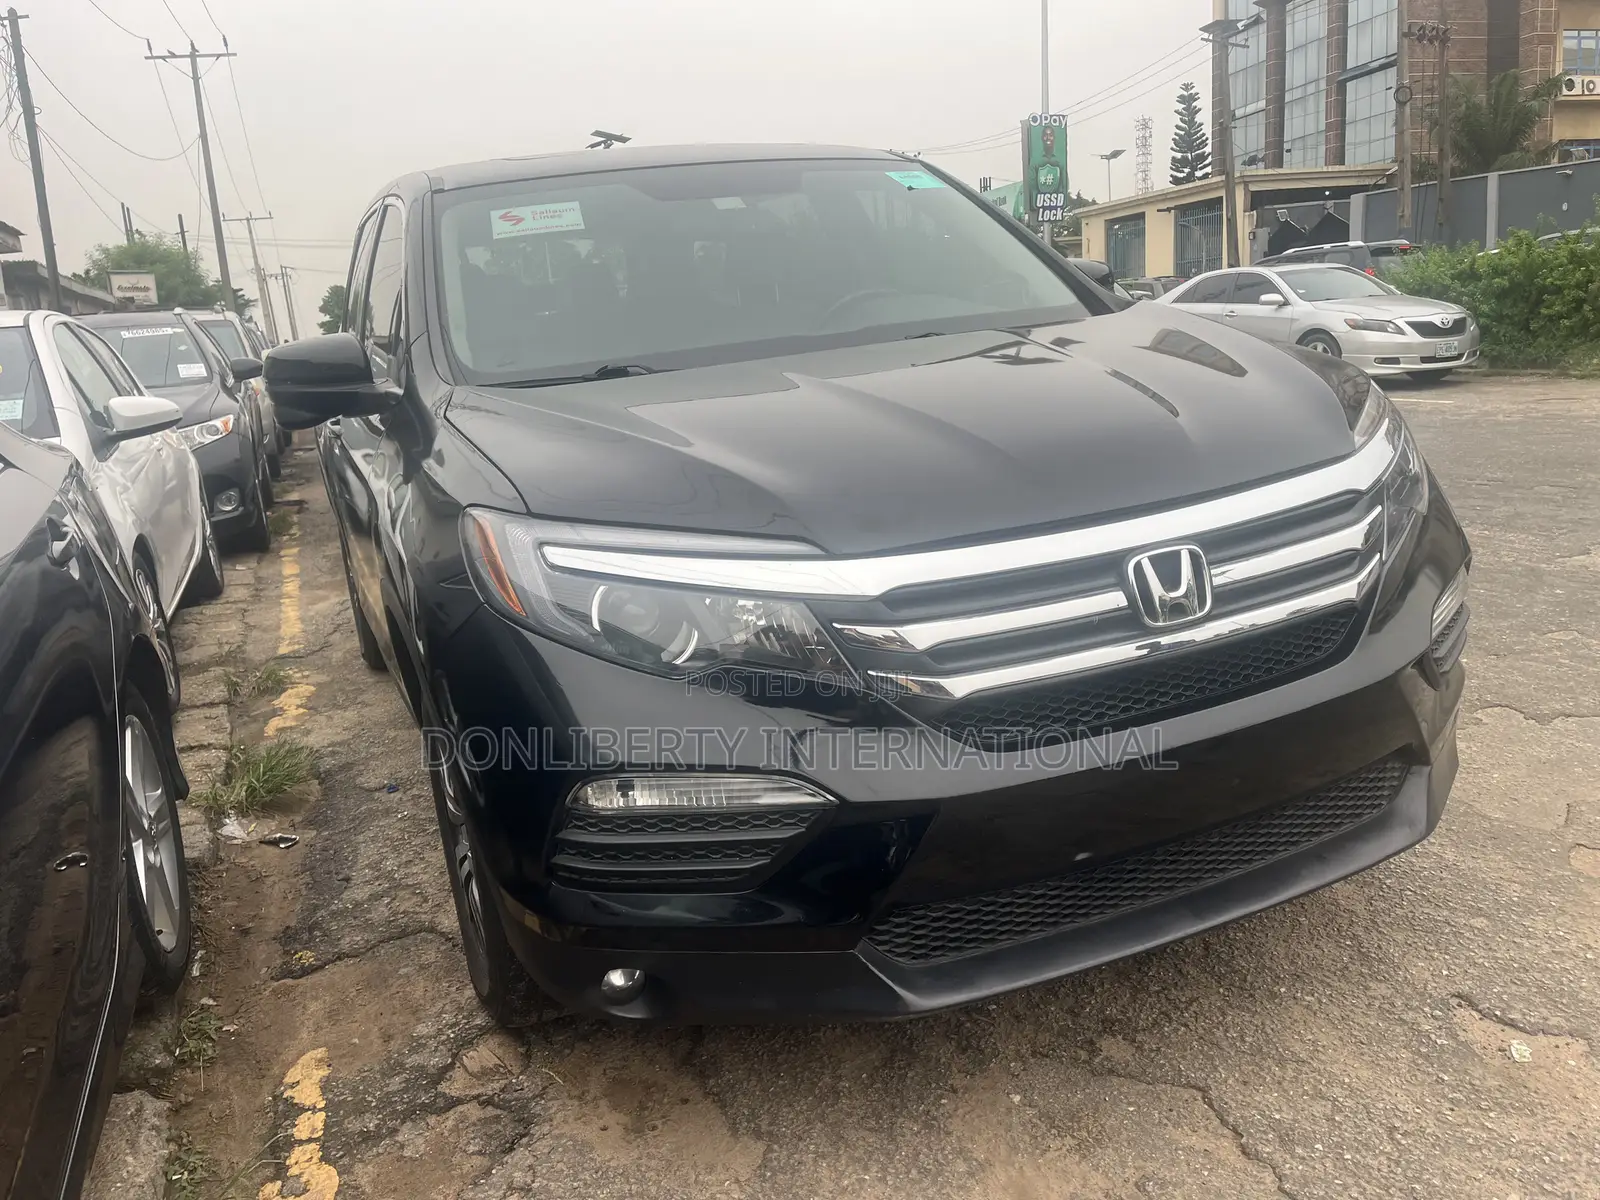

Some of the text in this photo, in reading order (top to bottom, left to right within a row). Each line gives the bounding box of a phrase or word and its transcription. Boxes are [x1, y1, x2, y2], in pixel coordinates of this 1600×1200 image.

[1029, 113, 1068, 128] OPay
[1036, 193, 1065, 207] USSD
[532, 213, 562, 221] Lines
